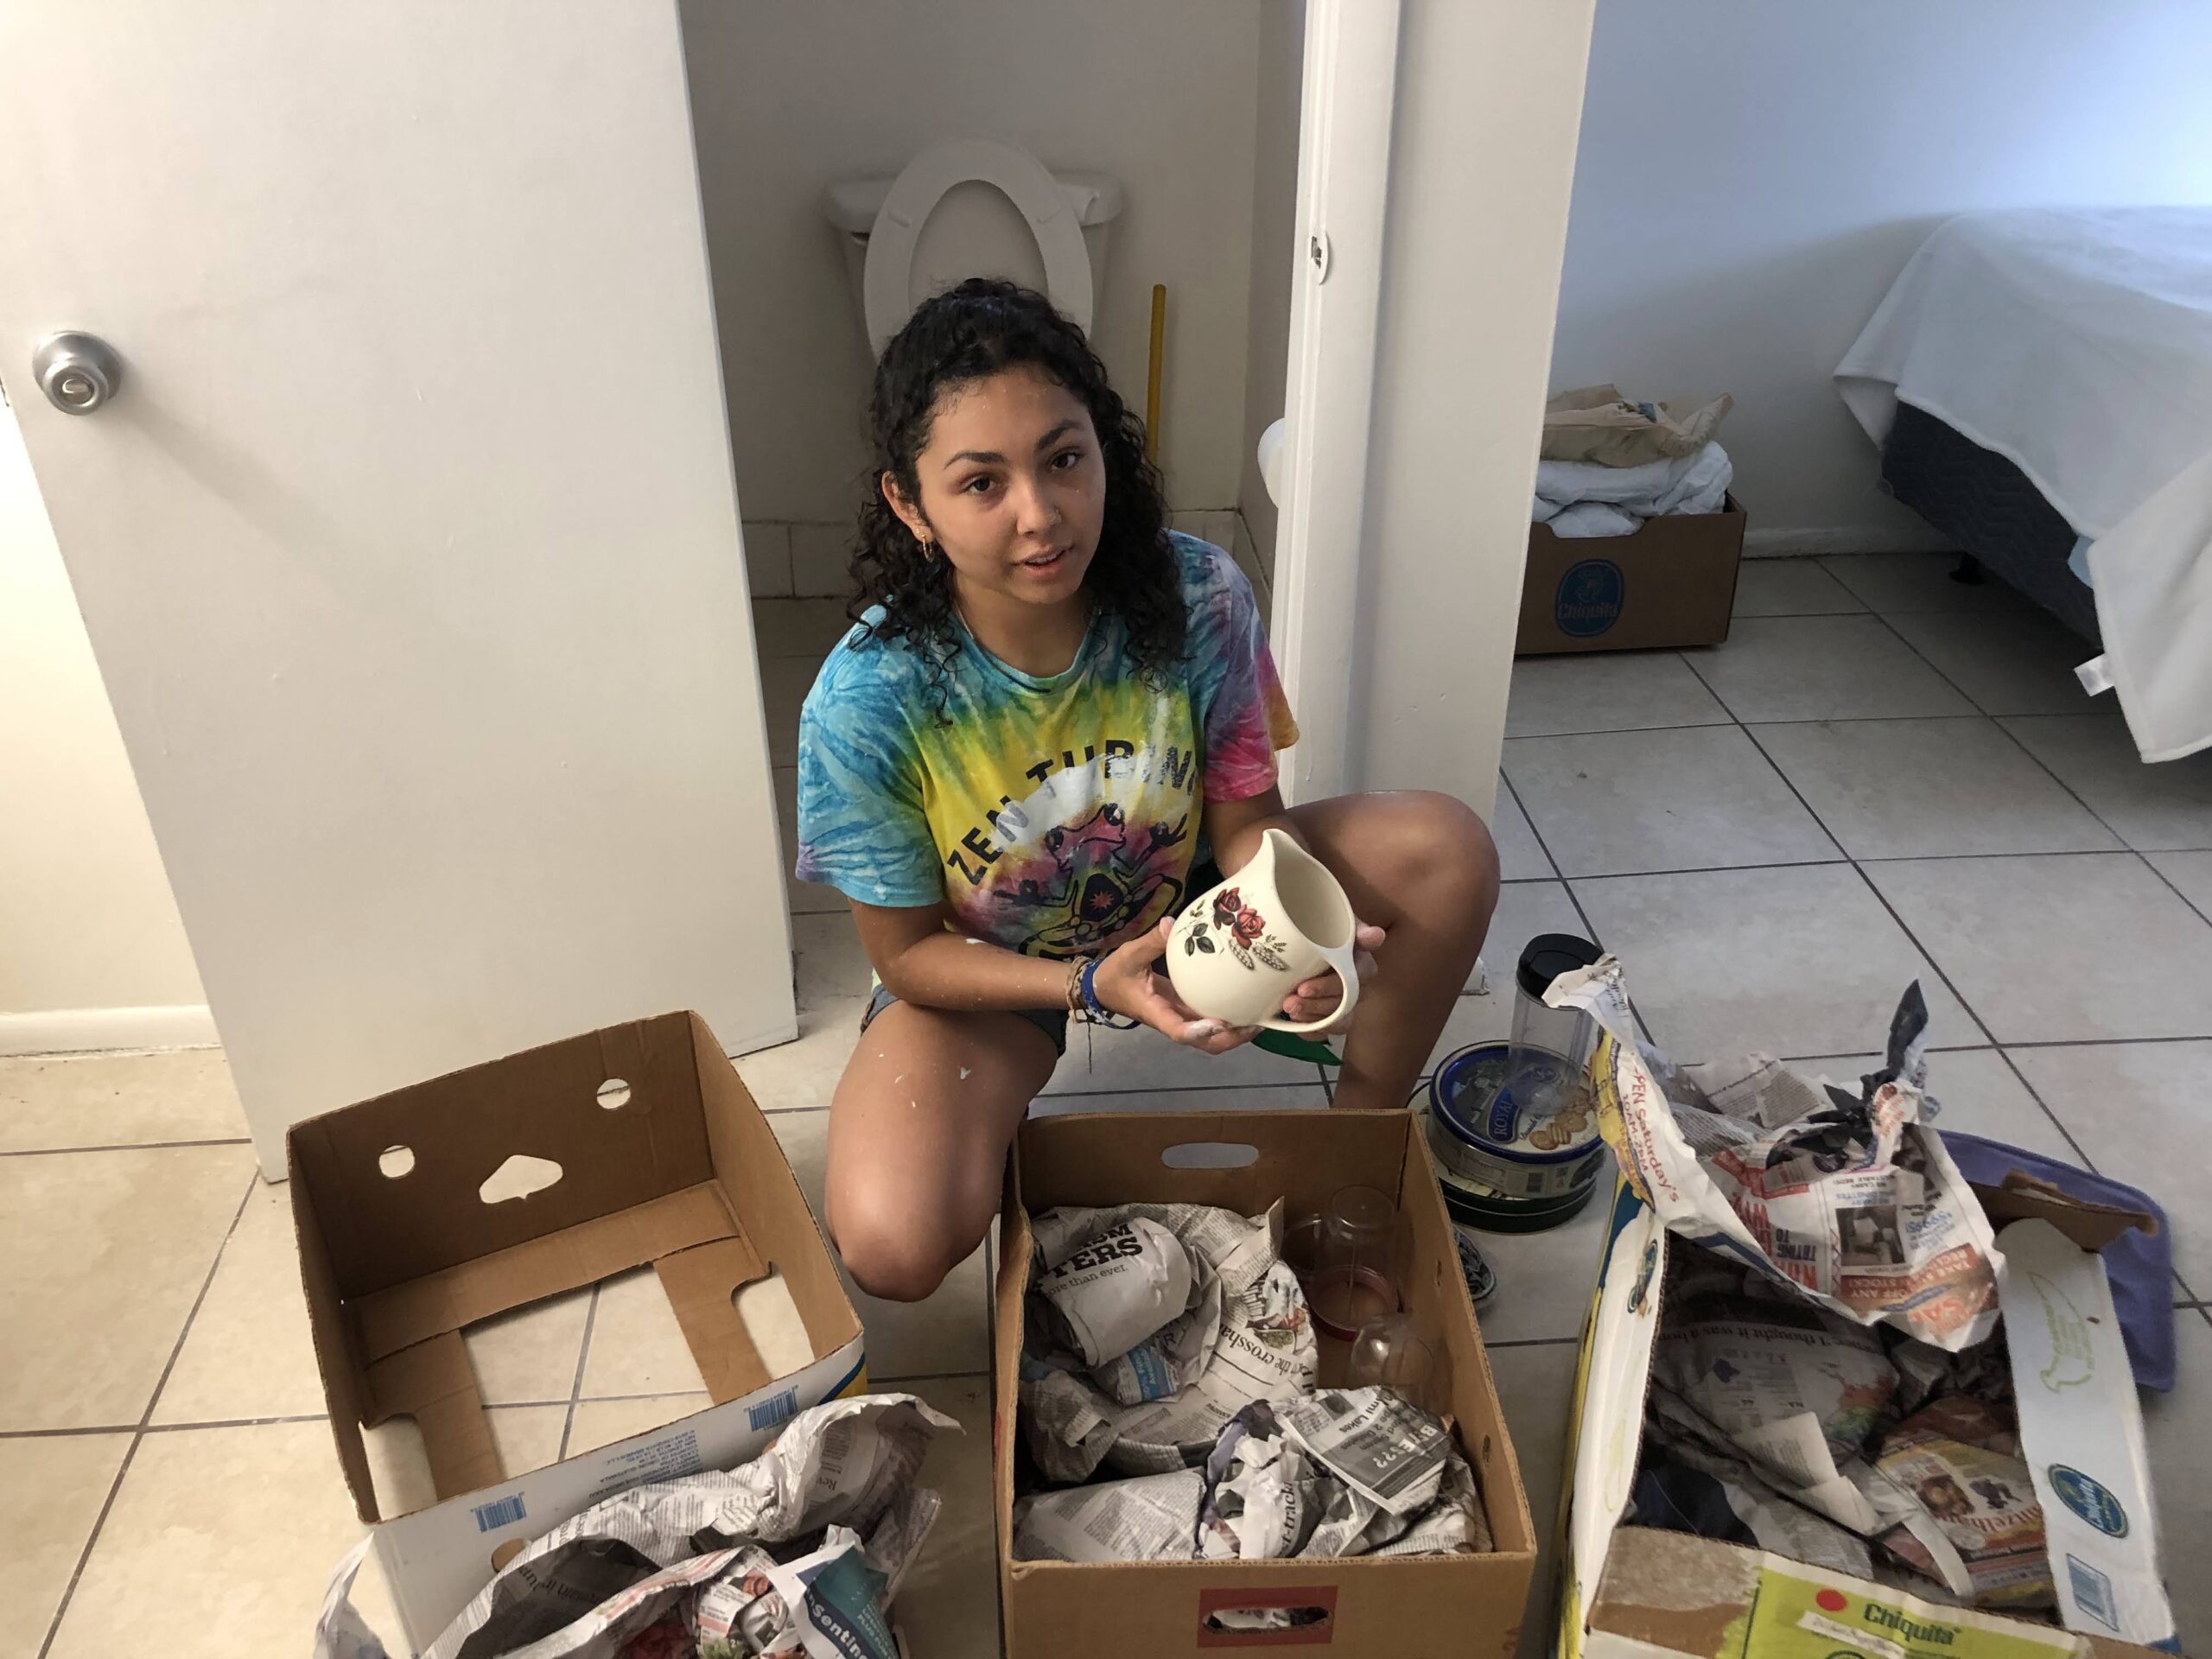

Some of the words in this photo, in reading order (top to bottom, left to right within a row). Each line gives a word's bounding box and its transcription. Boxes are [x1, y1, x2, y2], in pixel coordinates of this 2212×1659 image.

[1558, 601, 1618, 622] Chiquita
[947, 795, 1029, 886] ZEN
[1635, 1108, 1680, 1203] Saturday's
[1068, 1271, 1100, 1287] than
[1863, 1603, 1955, 1646] Chiquita
